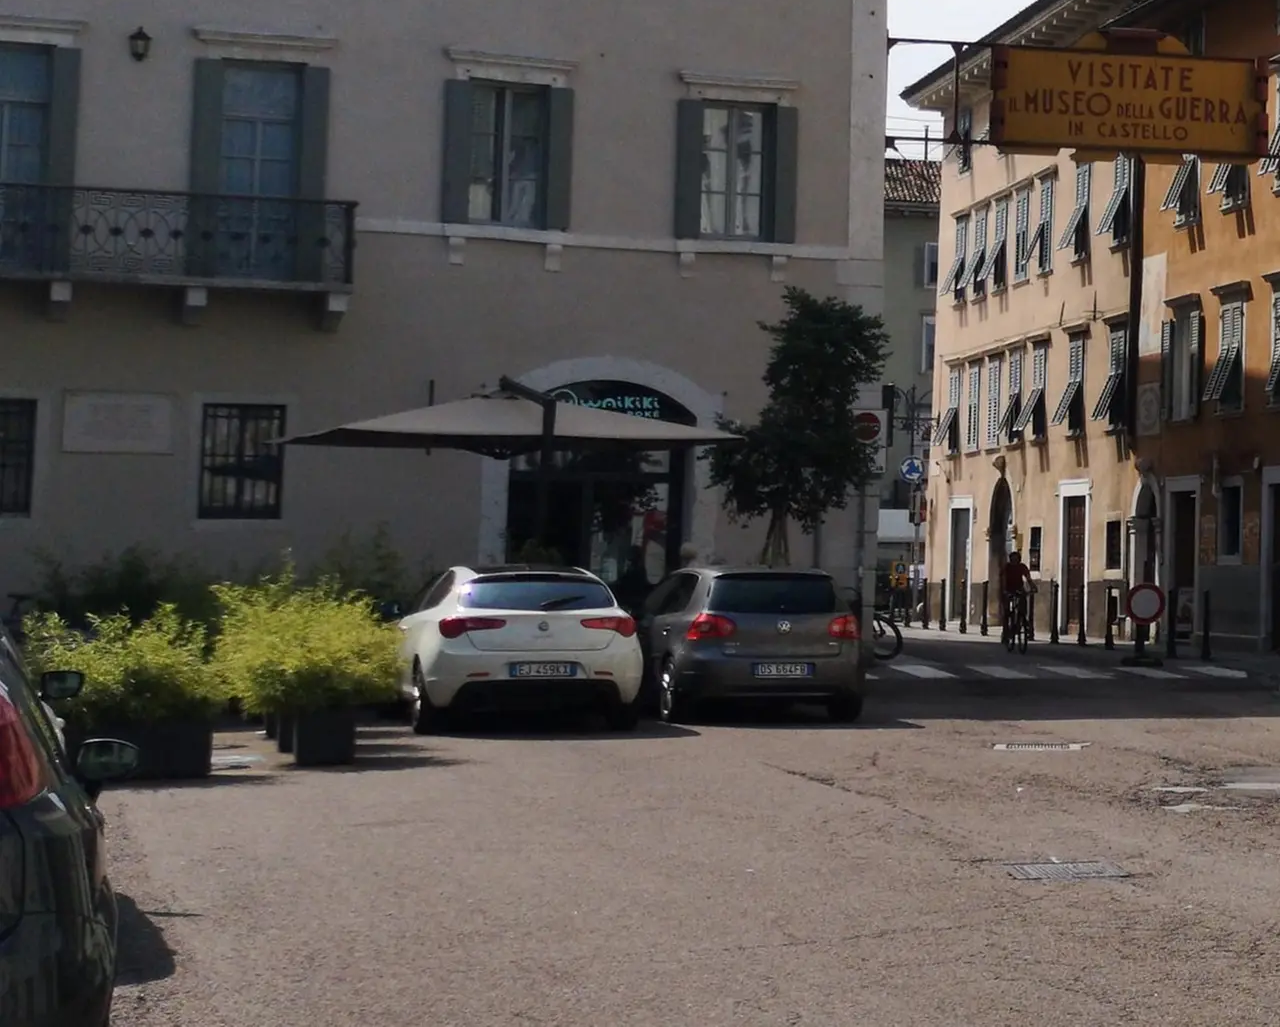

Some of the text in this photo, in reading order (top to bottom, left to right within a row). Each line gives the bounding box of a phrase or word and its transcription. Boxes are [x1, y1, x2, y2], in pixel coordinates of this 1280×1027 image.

[1068, 60, 1193, 92] VISITATE
[1008, 88, 1248, 124] IL MUSEO DELLA GUERRA
[1068, 120, 1188, 141] IN CASTELLO
